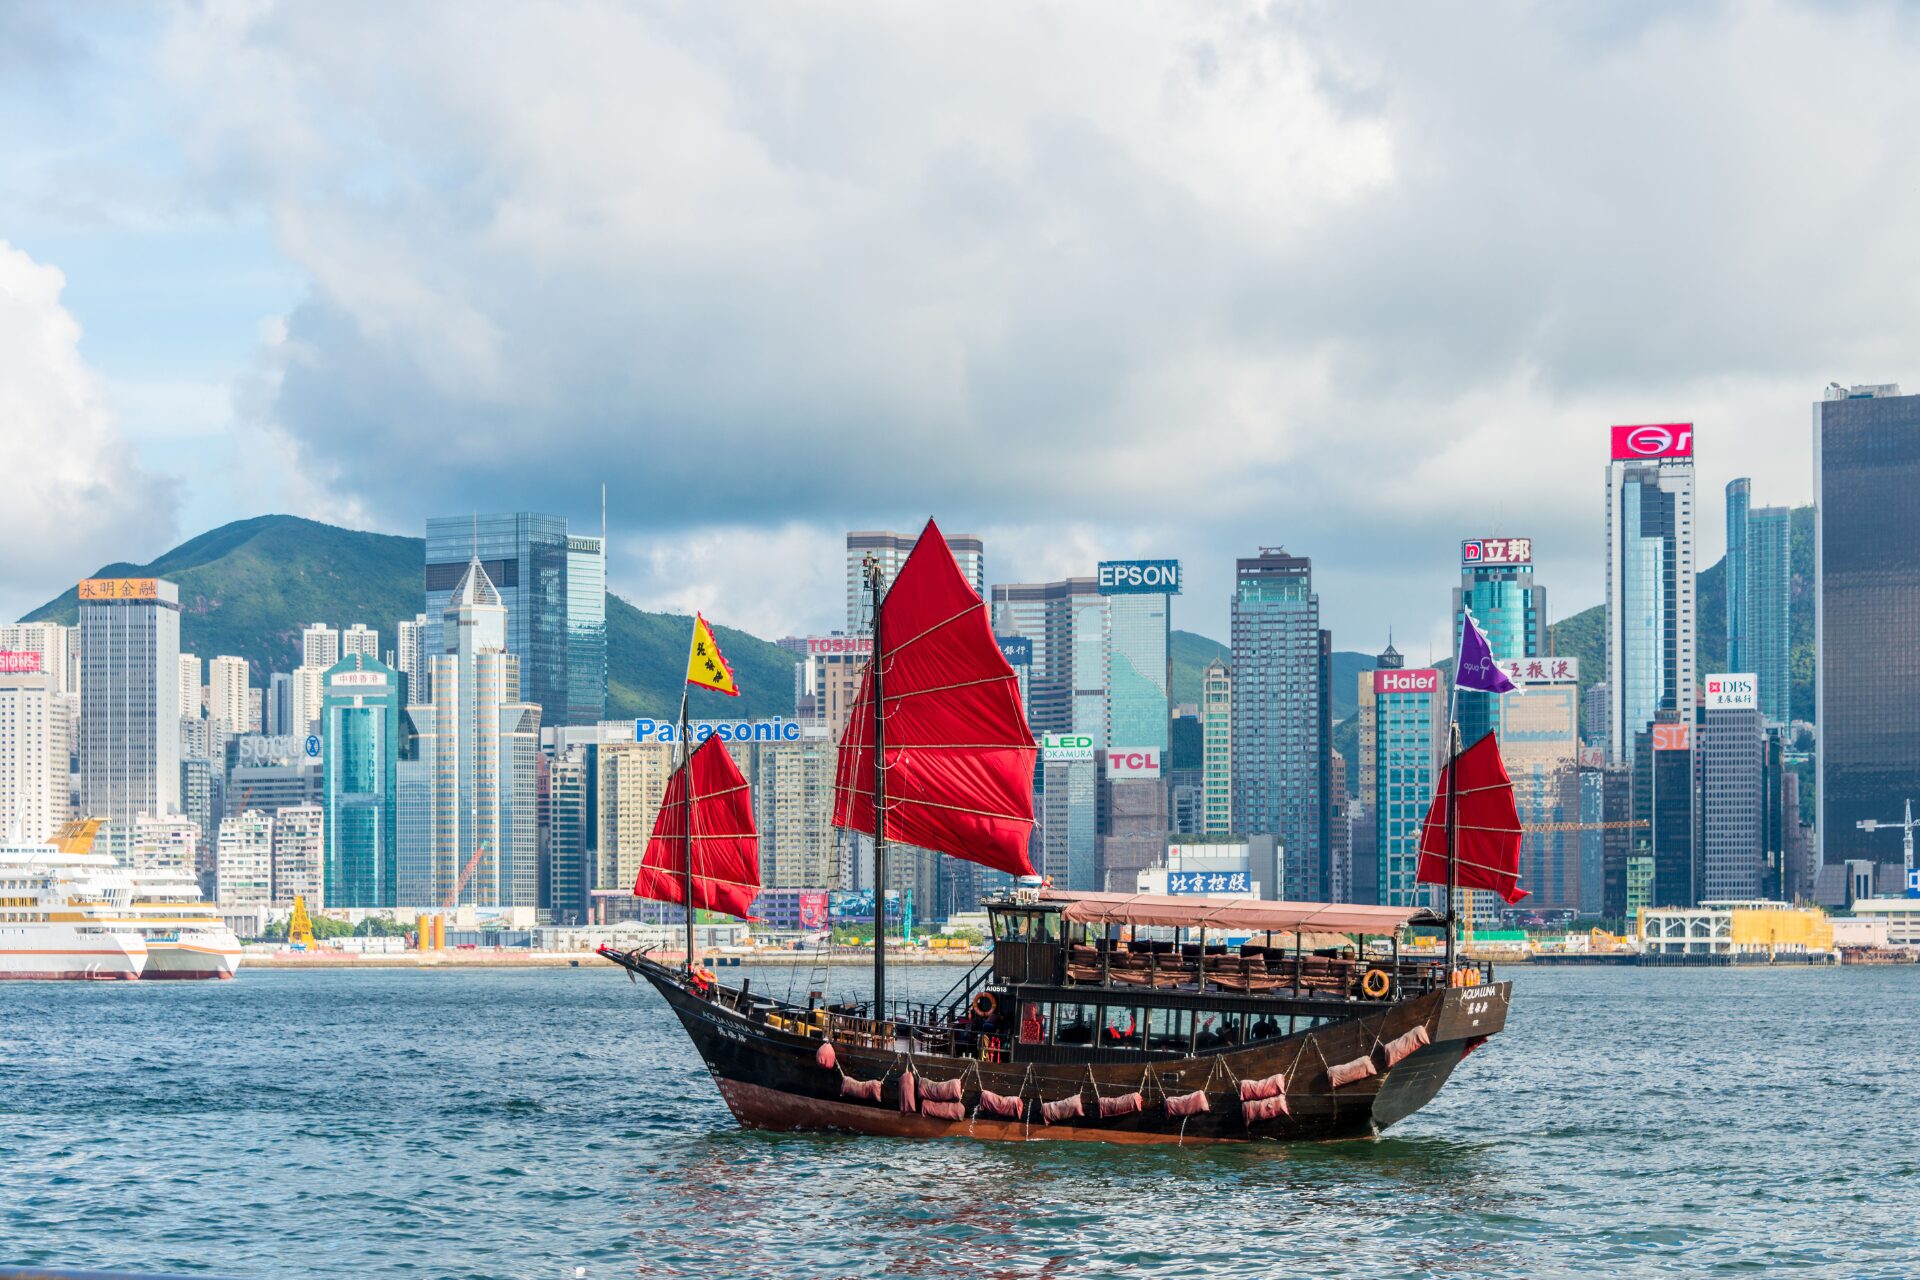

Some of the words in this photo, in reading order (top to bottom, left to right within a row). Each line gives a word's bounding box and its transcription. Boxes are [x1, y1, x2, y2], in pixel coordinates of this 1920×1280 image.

[568, 540, 600, 551] anulife
[1484, 539, 1530, 562] 立邦
[1100, 566, 1177, 586] EPSON
[81, 580, 156, 598] 永明金融
[807, 639, 874, 652] TOSHIB
[998, 645, 1026, 655] 銀行
[1383, 673, 1435, 690] Haier
[1722, 681, 1752, 692] DBS
[635, 716, 800, 743] Panasonic
[1044, 737, 1093, 748] LED
[1044, 750, 1093, 758] OKAMURA
[1108, 753, 1159, 770] TCL
[1171, 873, 1248, 892] 北京控股
